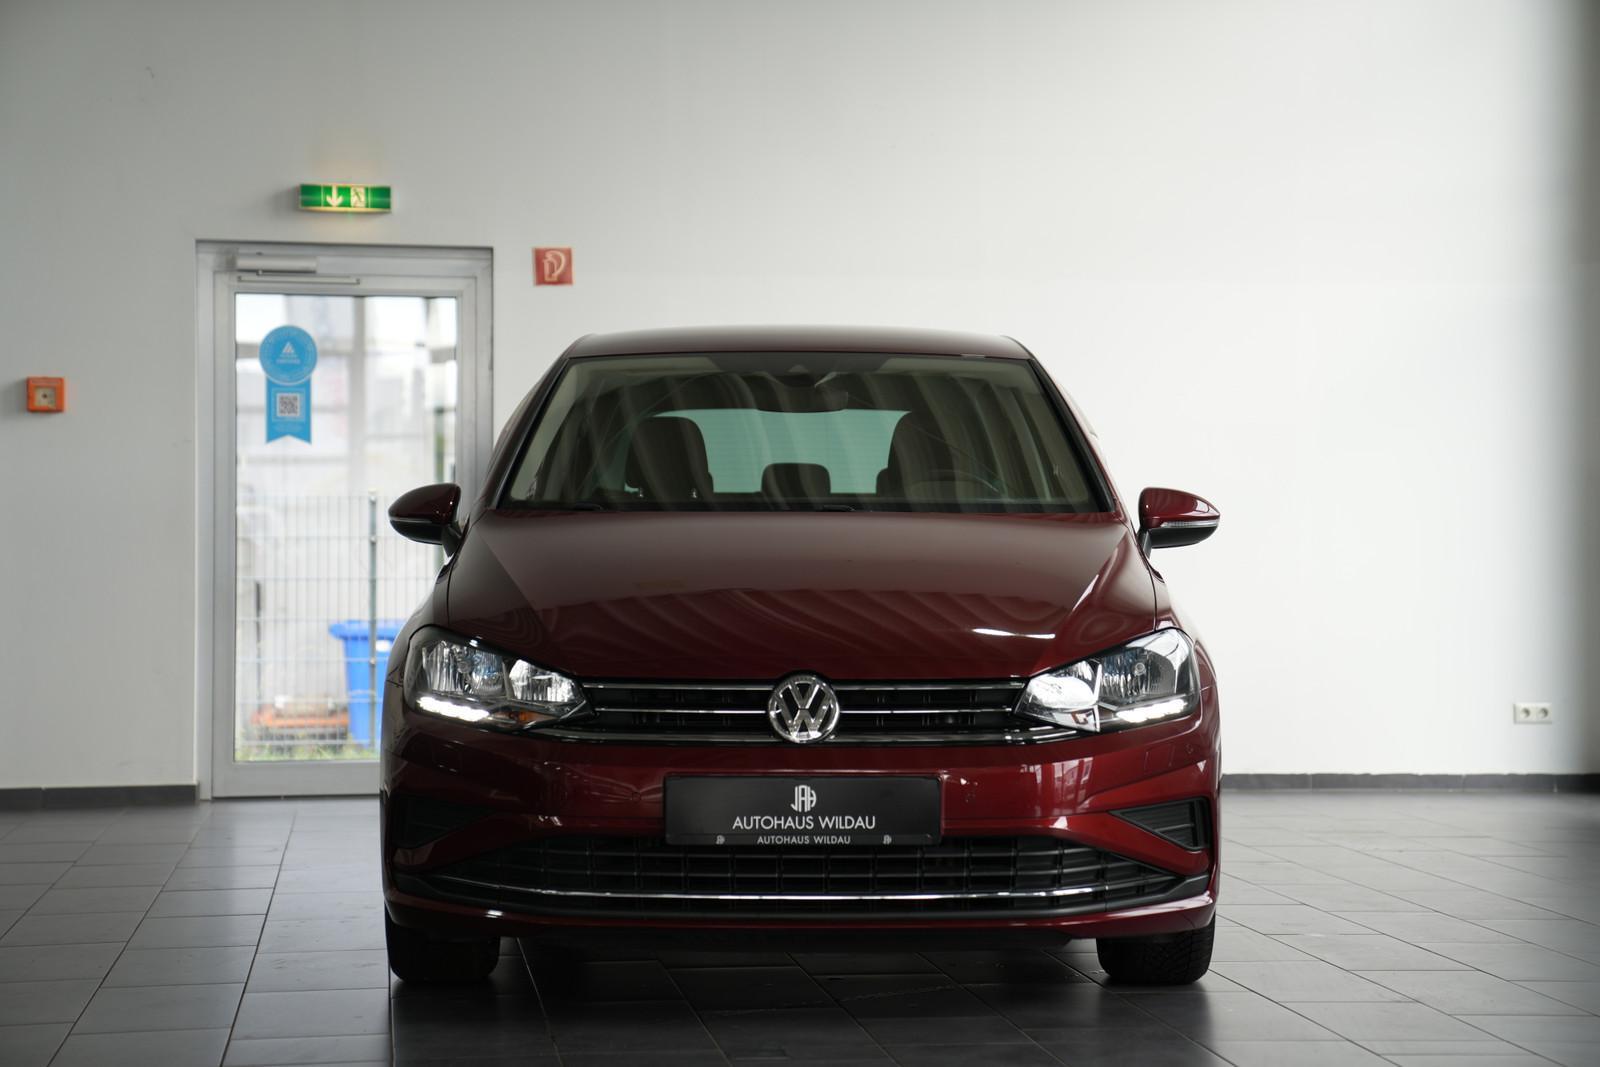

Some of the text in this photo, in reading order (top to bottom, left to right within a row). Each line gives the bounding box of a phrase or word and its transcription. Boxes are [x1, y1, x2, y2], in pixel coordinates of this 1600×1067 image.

[770, 676, 838, 742] VW
[732, 815, 876, 830] AUTOHAUS WILDAU
[757, 835, 851, 845] AUTOHAUS WILDAU
